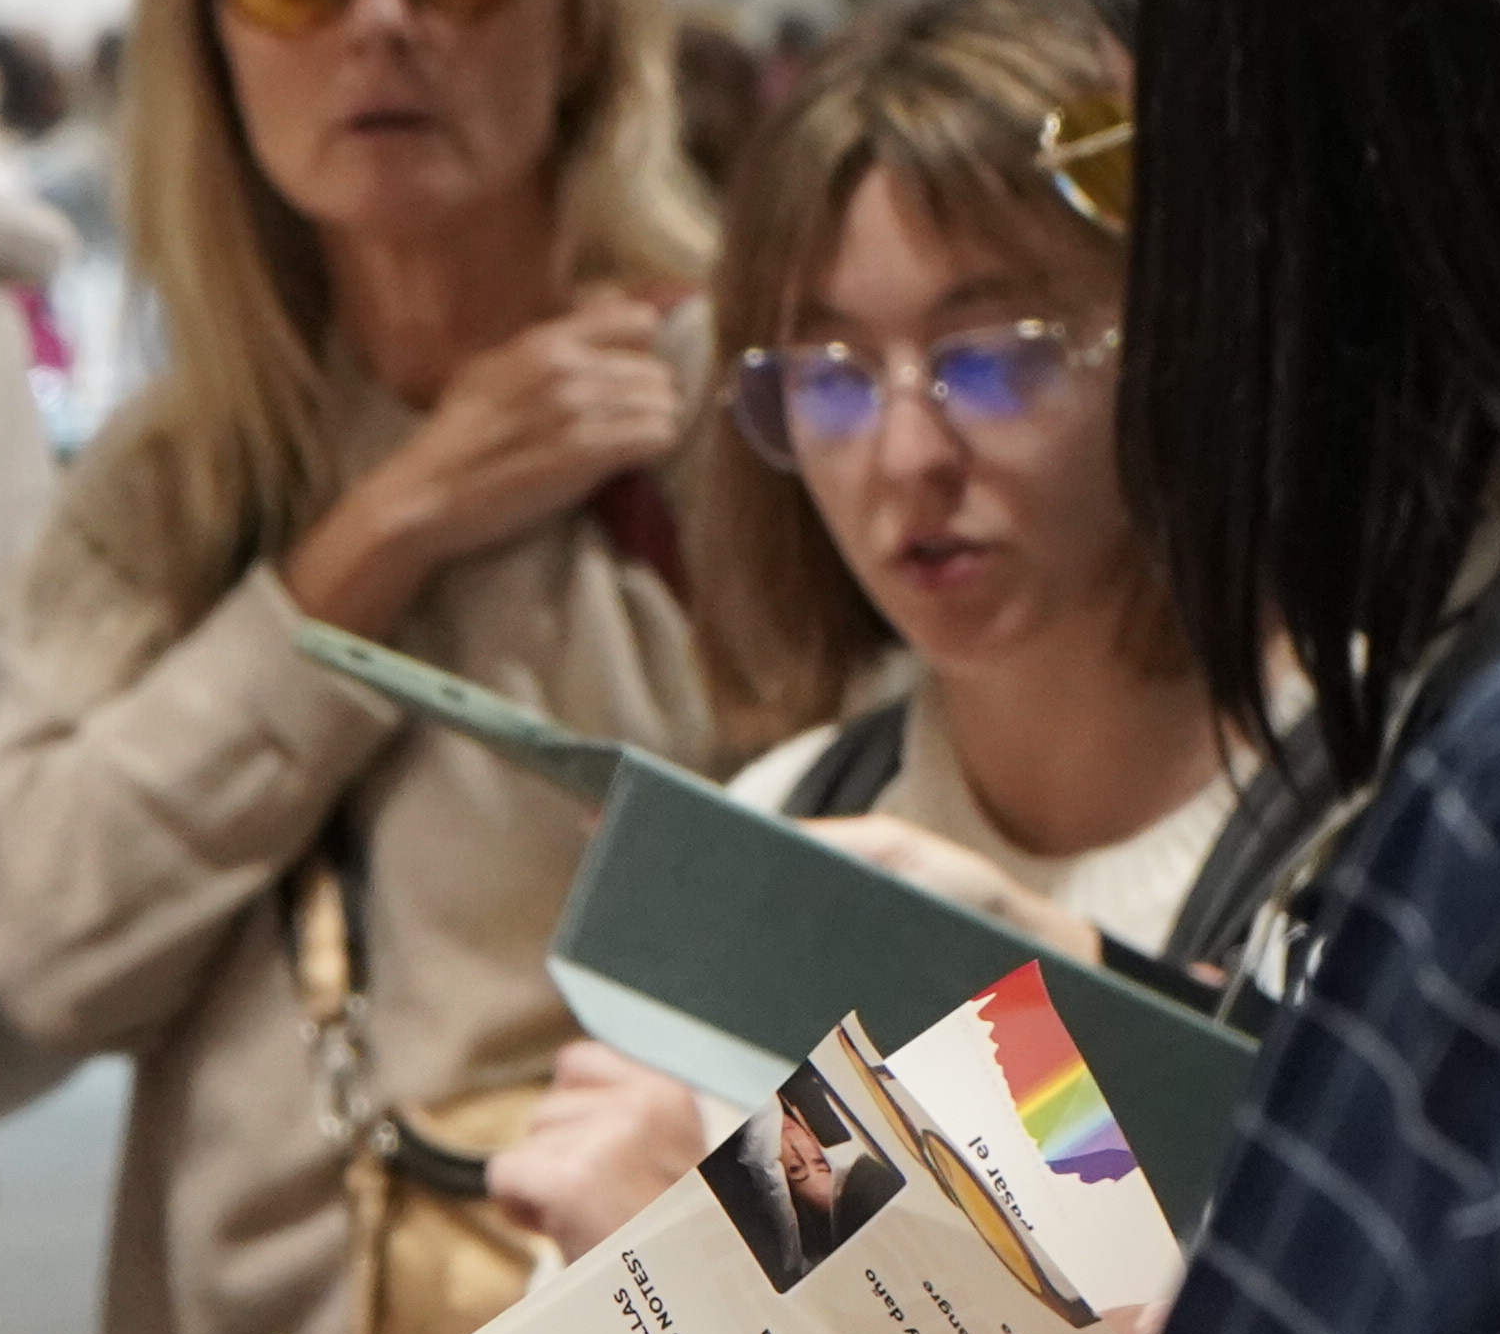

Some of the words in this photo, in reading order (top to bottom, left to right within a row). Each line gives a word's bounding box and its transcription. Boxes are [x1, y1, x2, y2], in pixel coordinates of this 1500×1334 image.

[967, 1136, 989, 1160] el
[621, 1249, 673, 1330] NOTES?
[864, 1268, 904, 1322] daño
